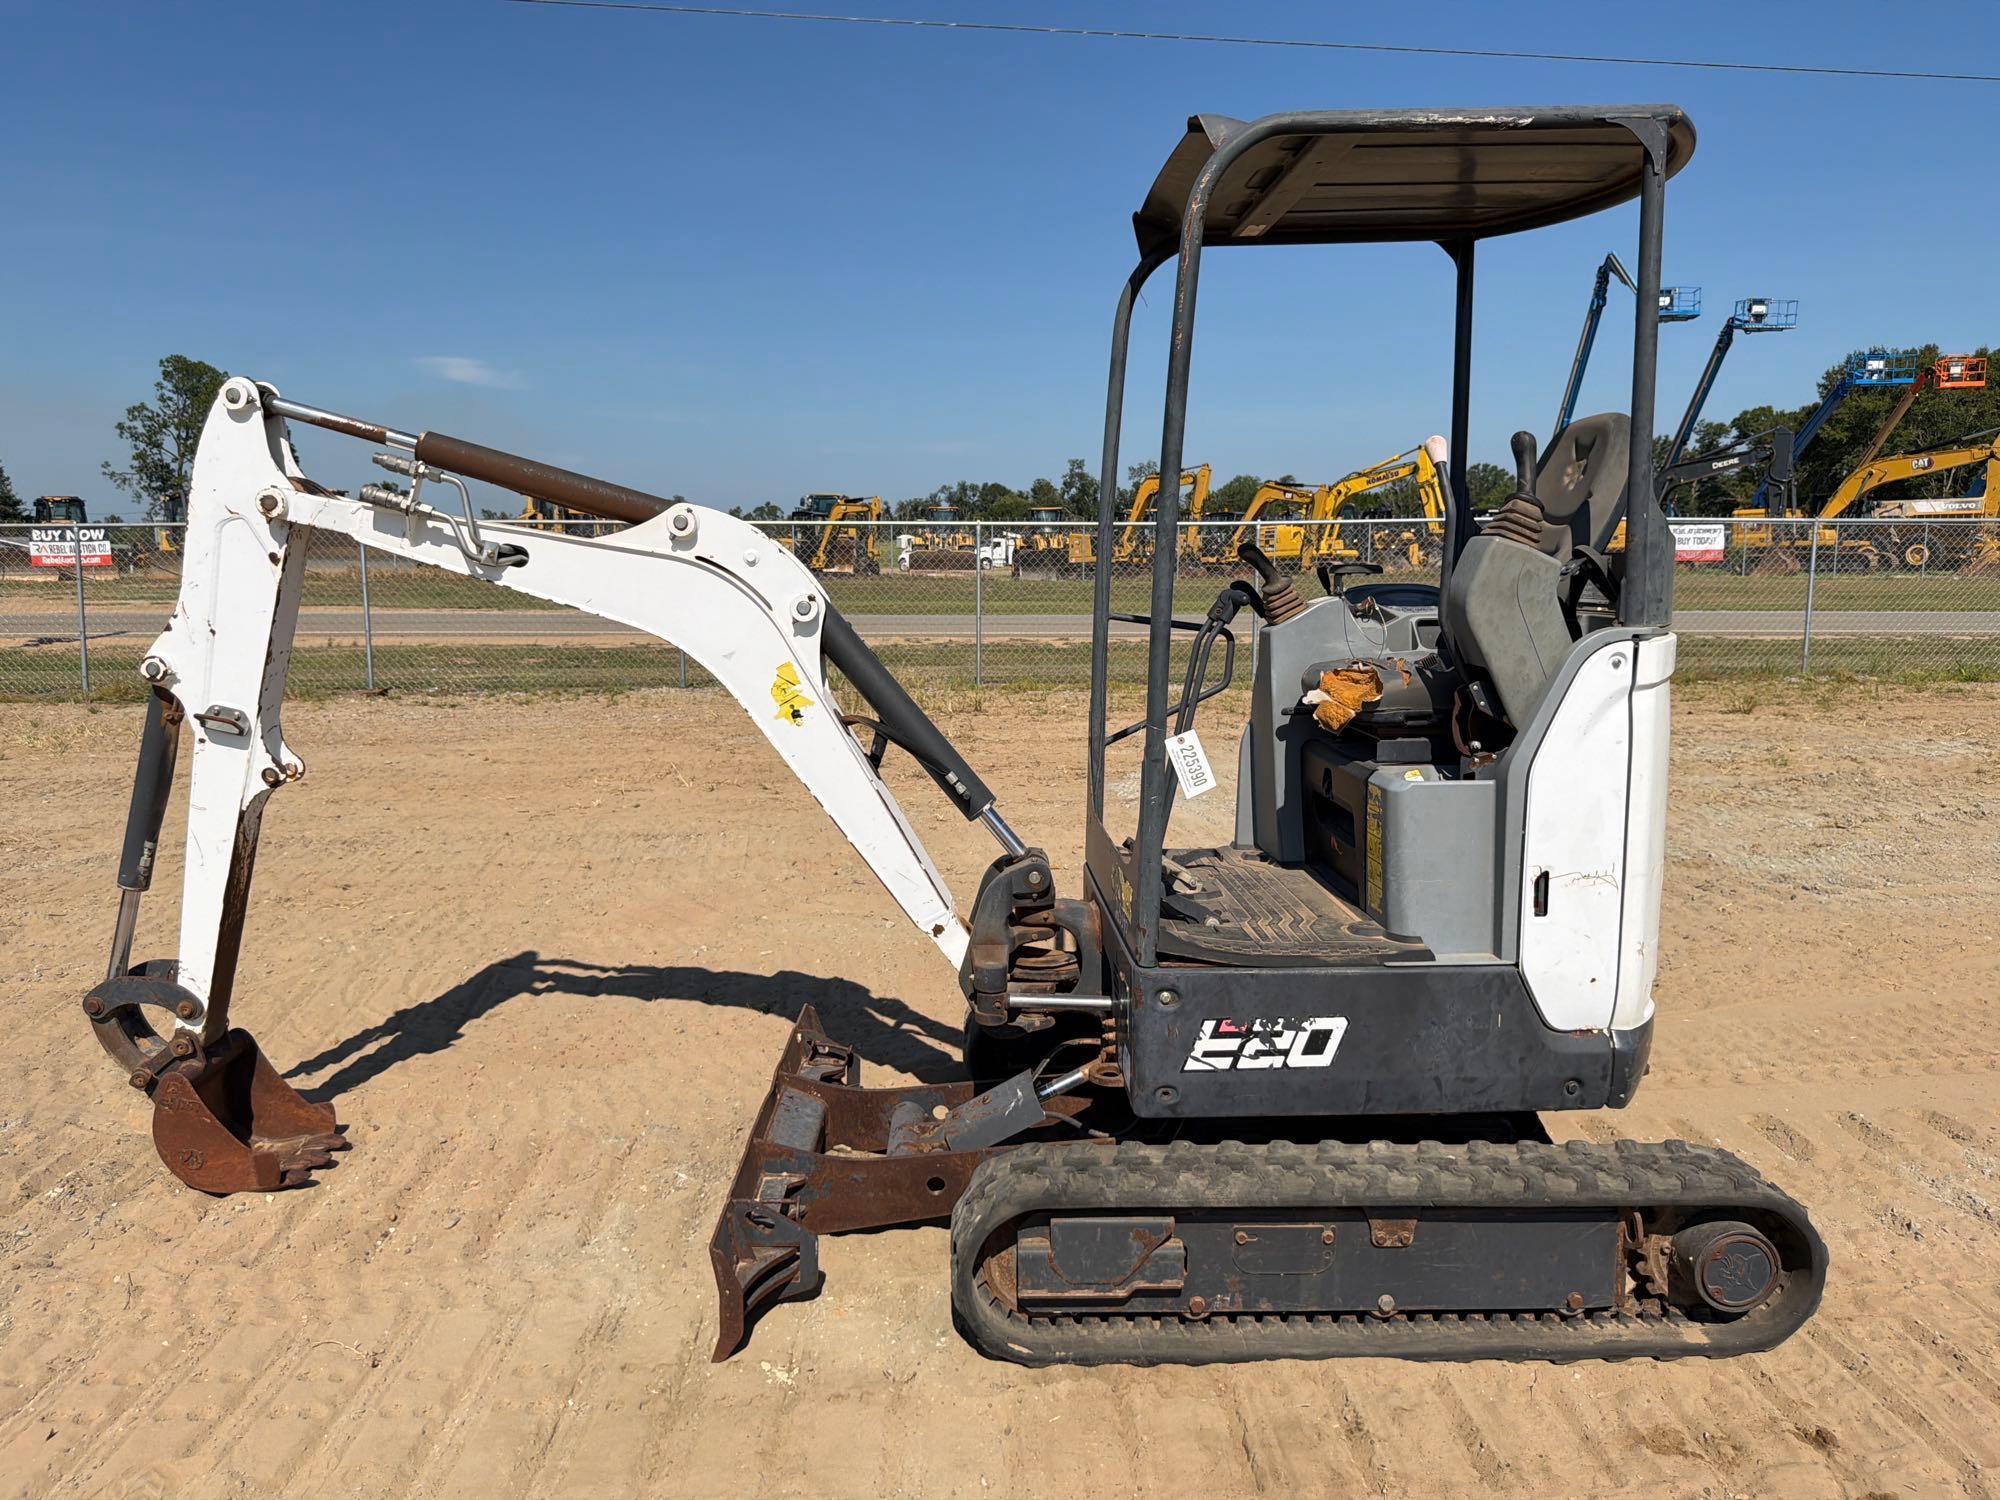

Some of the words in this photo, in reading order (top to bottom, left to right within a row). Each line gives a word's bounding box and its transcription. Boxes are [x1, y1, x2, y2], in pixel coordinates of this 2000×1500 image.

[1712, 457, 1740, 470] DEERE
[1912, 457, 1930, 470] CAT
[1366, 470, 1400, 486] KOMATSU
[32, 528, 62, 541] BUY
[65, 528, 105, 541] NOW
[48, 543, 67, 554] REBEL
[1180, 745, 1208, 787] 225390
